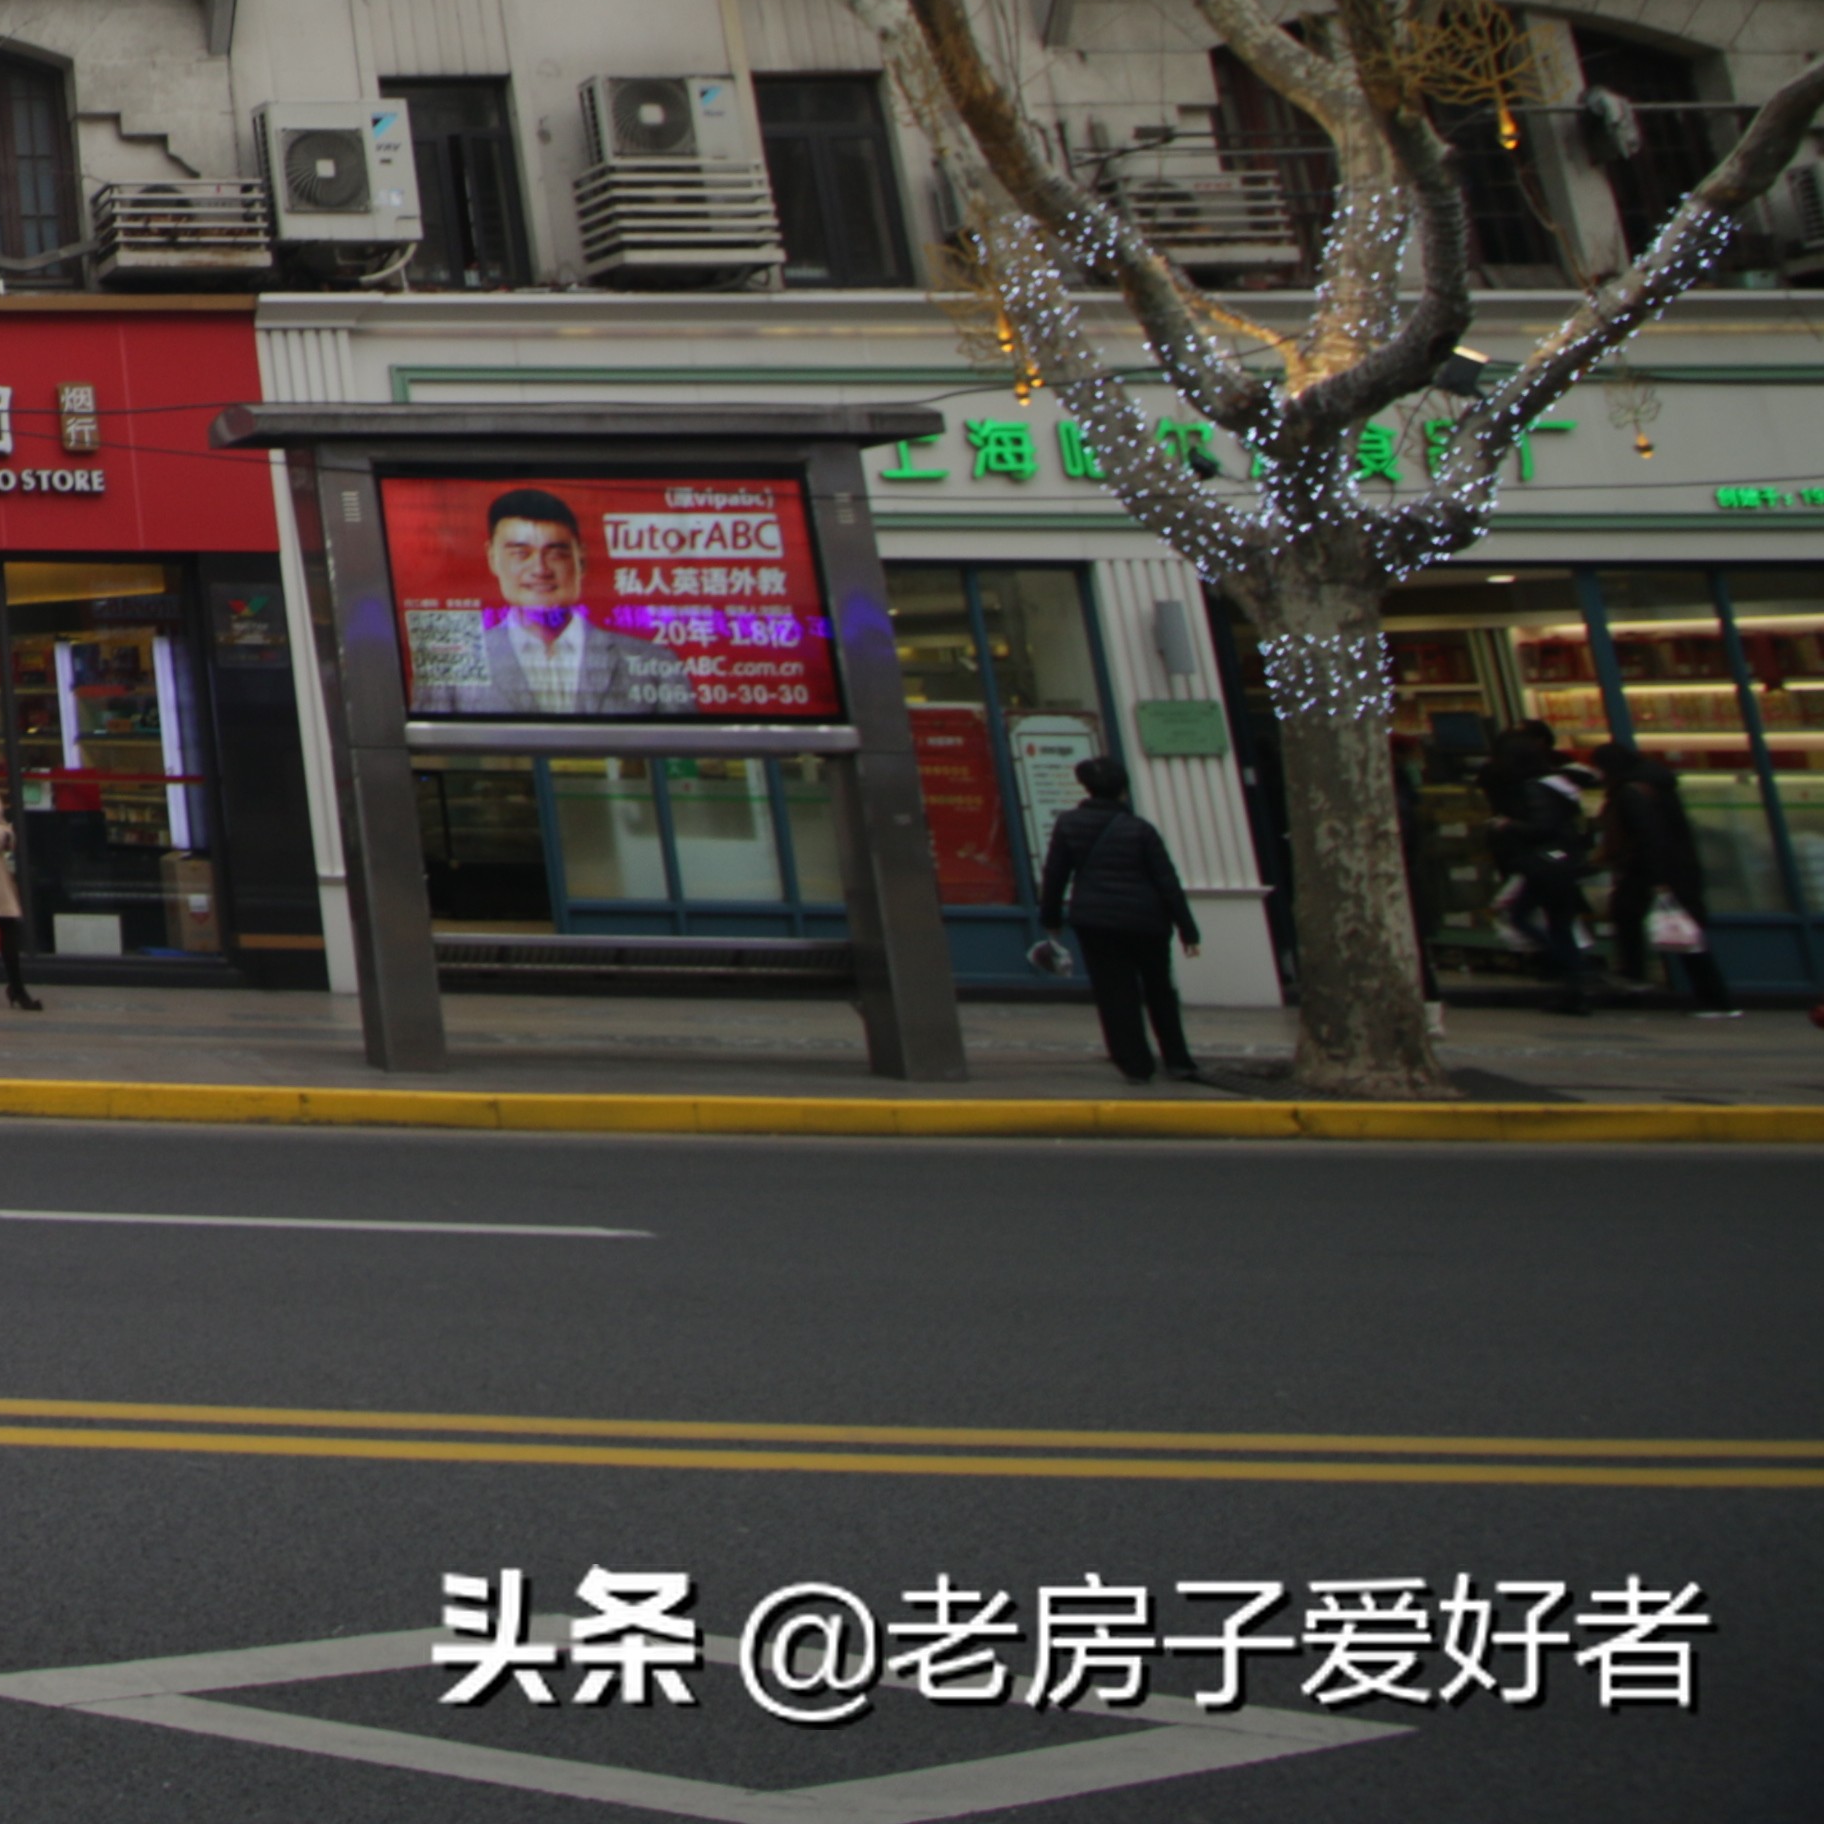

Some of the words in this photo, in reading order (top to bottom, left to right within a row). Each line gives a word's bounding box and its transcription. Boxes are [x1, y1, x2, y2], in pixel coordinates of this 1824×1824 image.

[60, 385, 96, 449] 烟行
[21, 469, 107, 493] STORE
[604, 520, 780, 554] TutorABC
[614, 567, 787, 596] 私人英语外教
[652, 619, 718, 648] 20年
[625, 656, 804, 677] TutorABC.com.cn
[628, 684, 809, 705] 4006-30-30-30
